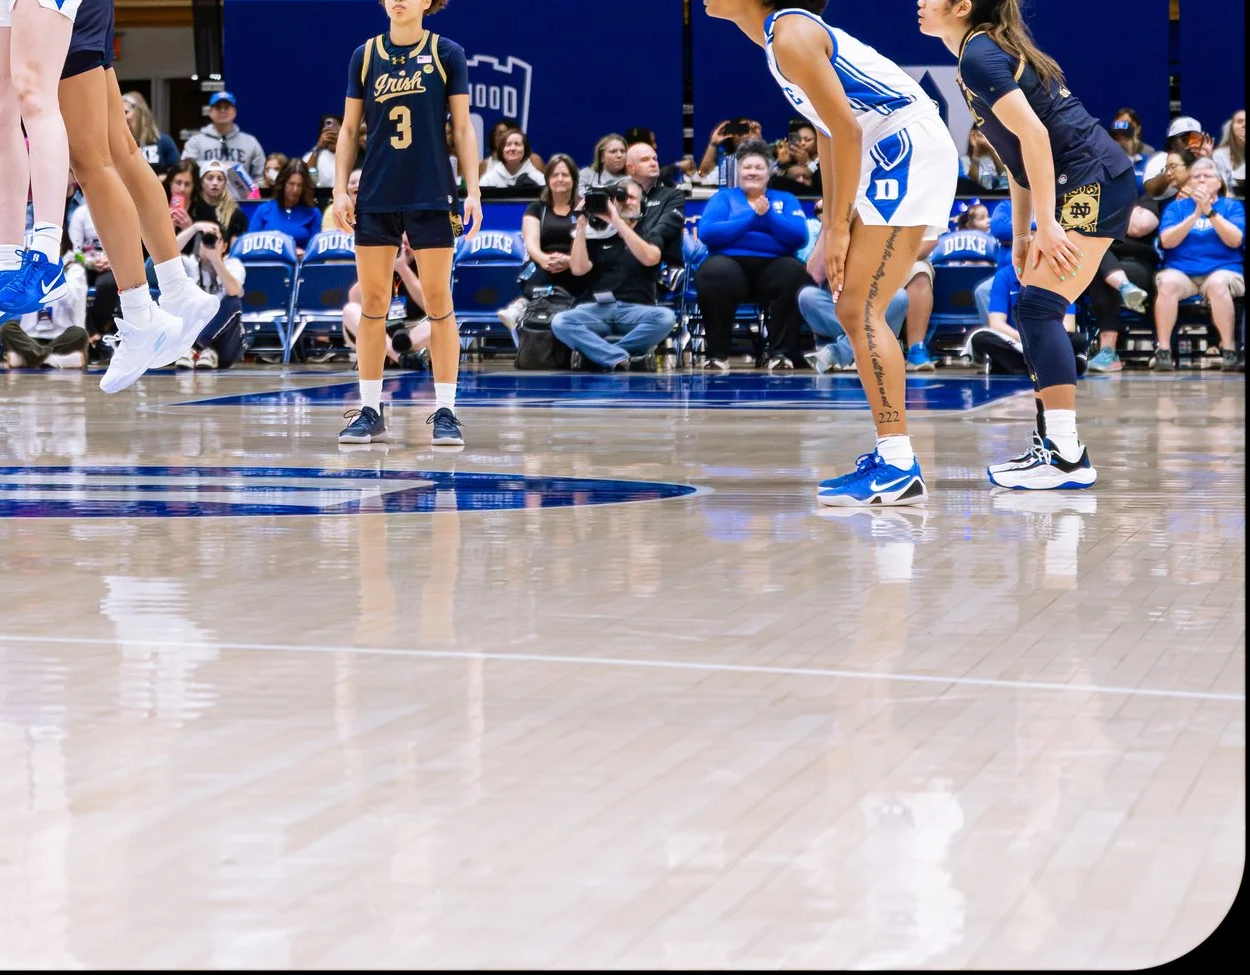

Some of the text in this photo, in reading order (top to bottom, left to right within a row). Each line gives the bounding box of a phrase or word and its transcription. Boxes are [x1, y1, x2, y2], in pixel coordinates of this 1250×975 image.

[373, 70, 426, 103] Irish
[469, 83, 518, 118] OOD
[389, 105, 413, 149] 3
[875, 178, 899, 201] D
[242, 233, 284, 255] DUKE
[471, 234, 513, 255] DUKE
[944, 235, 987, 256] DUKE
[878, 411, 900, 424] 222
